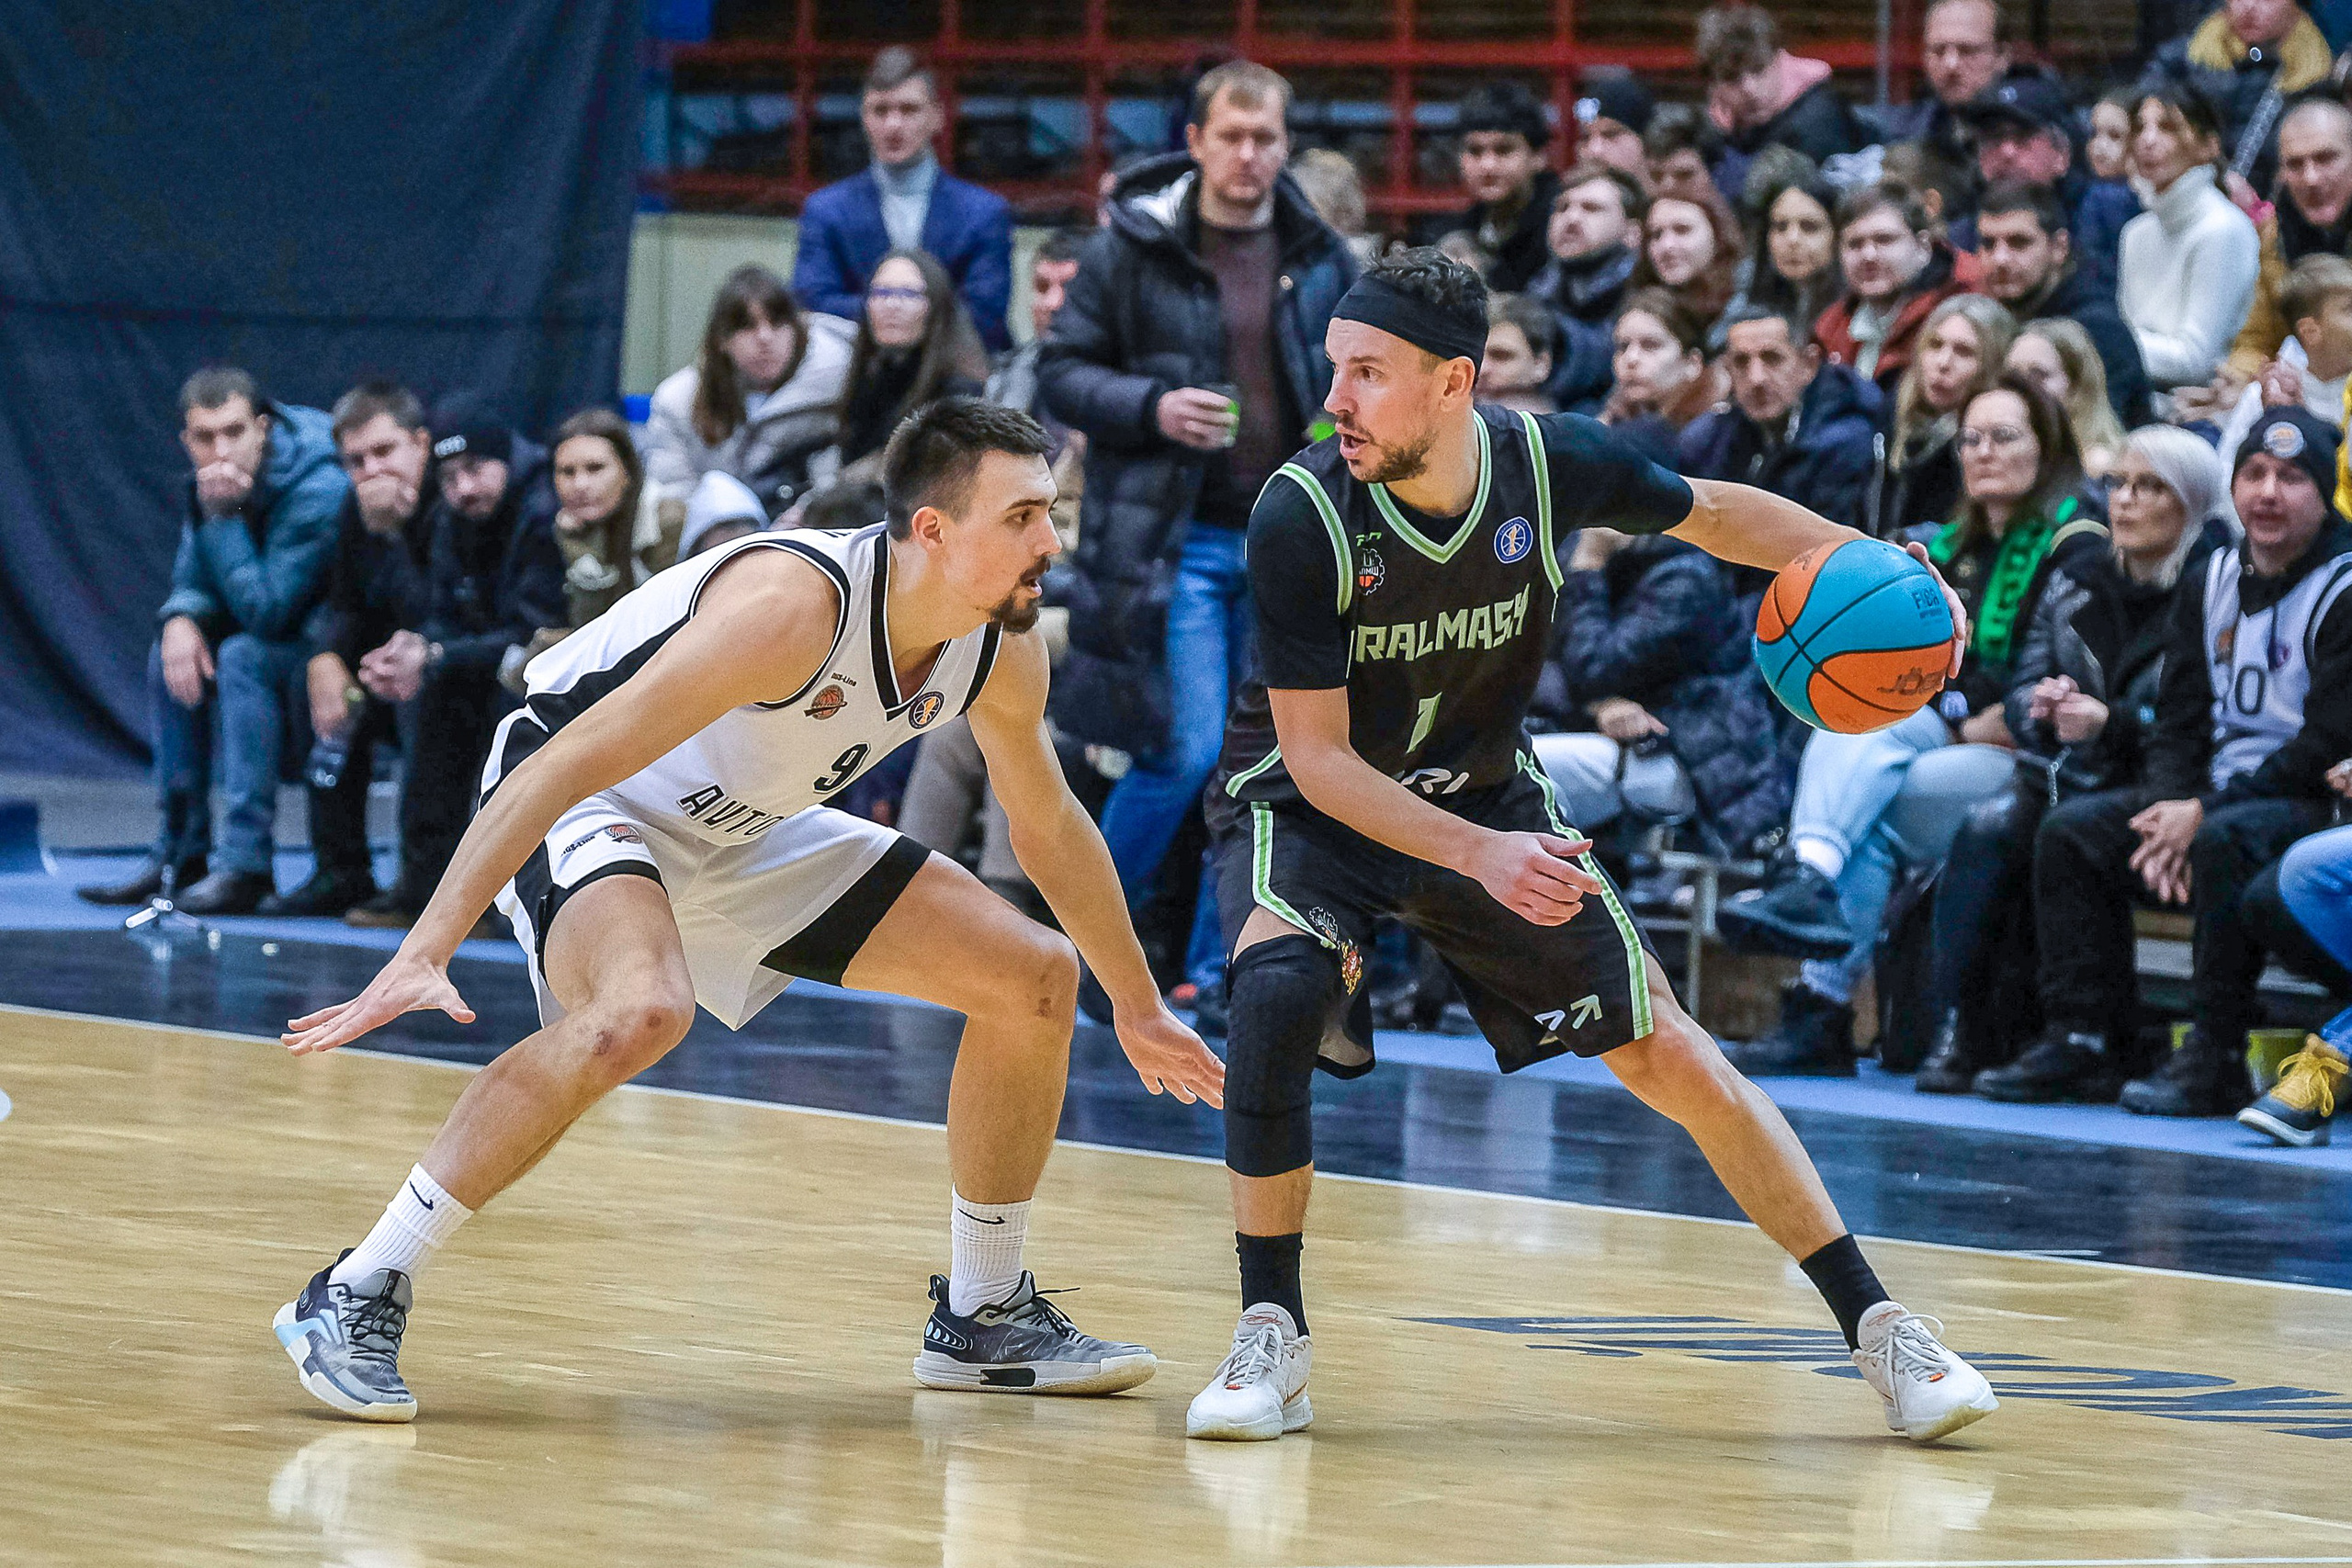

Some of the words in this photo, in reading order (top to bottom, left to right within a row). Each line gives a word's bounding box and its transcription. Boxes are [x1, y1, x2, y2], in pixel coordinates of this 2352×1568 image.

[1355, 582, 1531, 663] RALMASH
[812, 742, 871, 794] 9
[676, 784, 786, 838] AVTO
